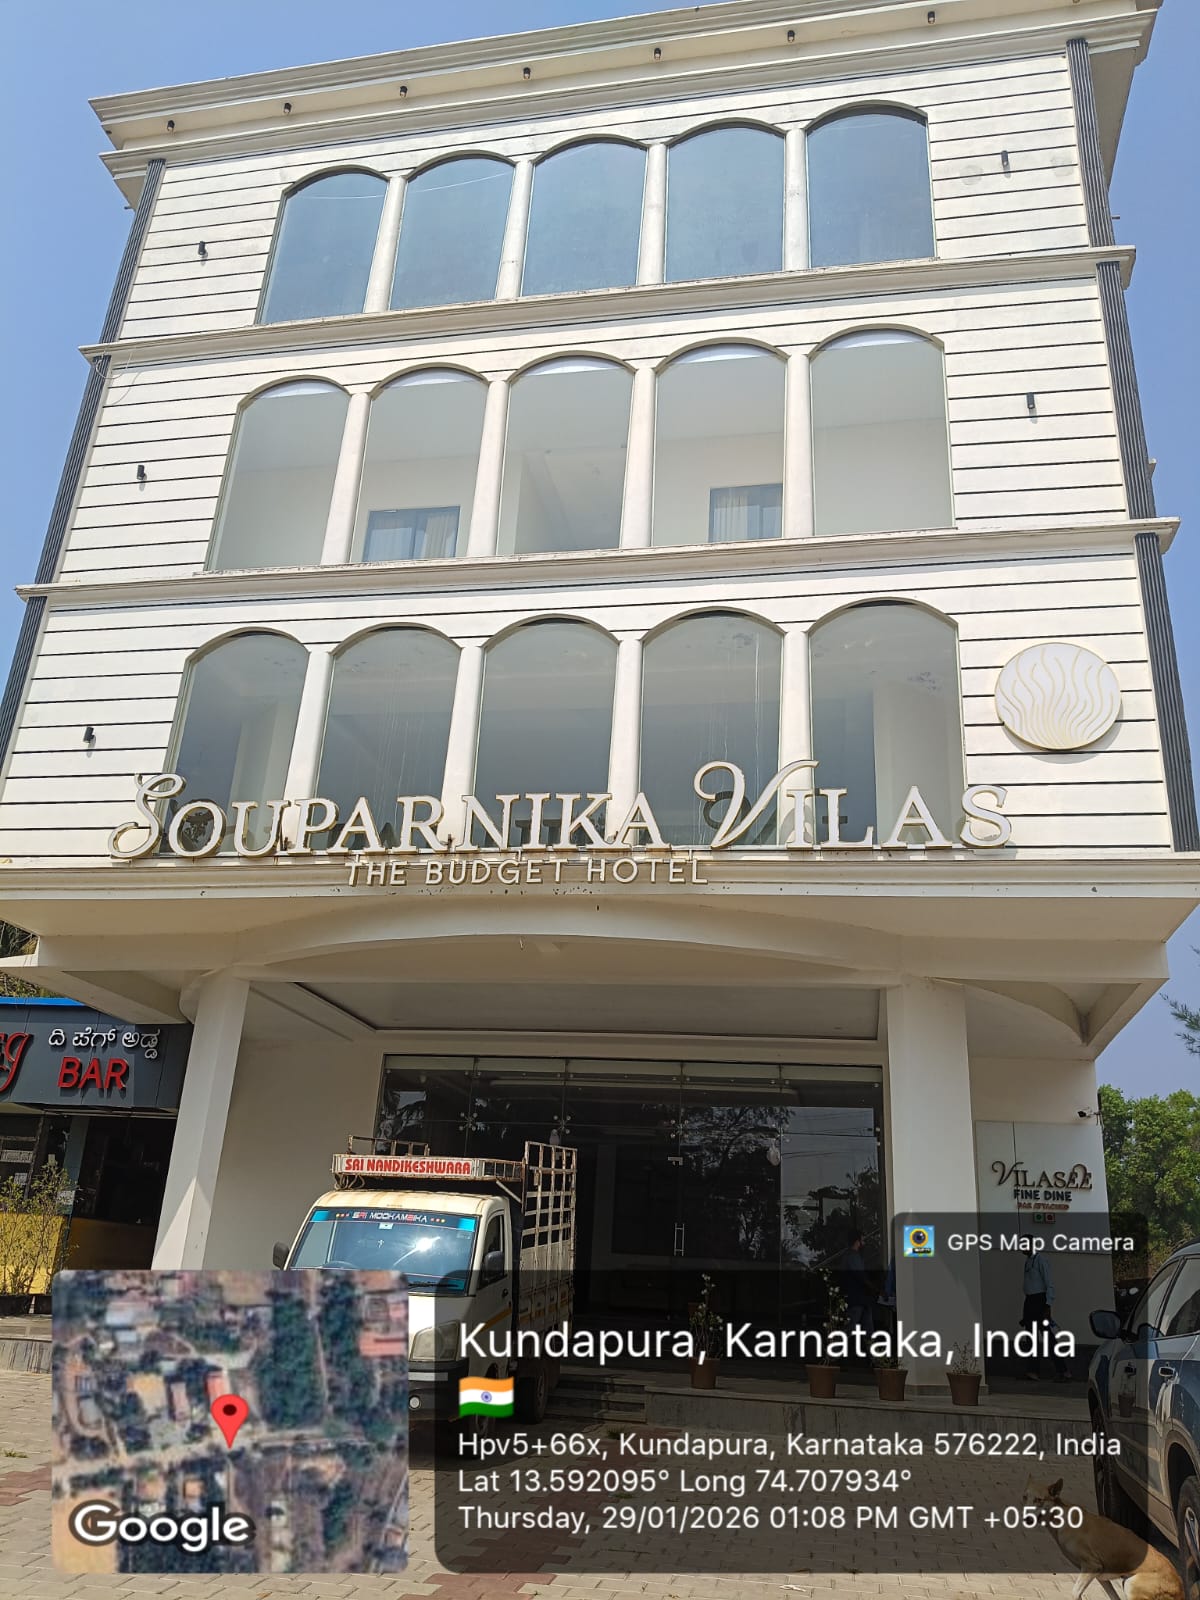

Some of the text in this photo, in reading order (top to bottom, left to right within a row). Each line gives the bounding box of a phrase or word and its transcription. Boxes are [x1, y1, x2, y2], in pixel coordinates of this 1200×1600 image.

[108, 759, 1013, 859] SOUPARNIKA VILAS
[345, 857, 708, 887] THE BUDGET HOTEL
[49, 1028, 66, 1047] ದಿ
[72, 1027, 116, 1048] ಪೆಗ್
[58, 1056, 130, 1090] BAR
[345, 1158, 471, 1175] SRI NANDIKESHWARA
[1013, 1189, 1073, 1202] FINE DINE
[351, 1210, 368, 1219] SRI
